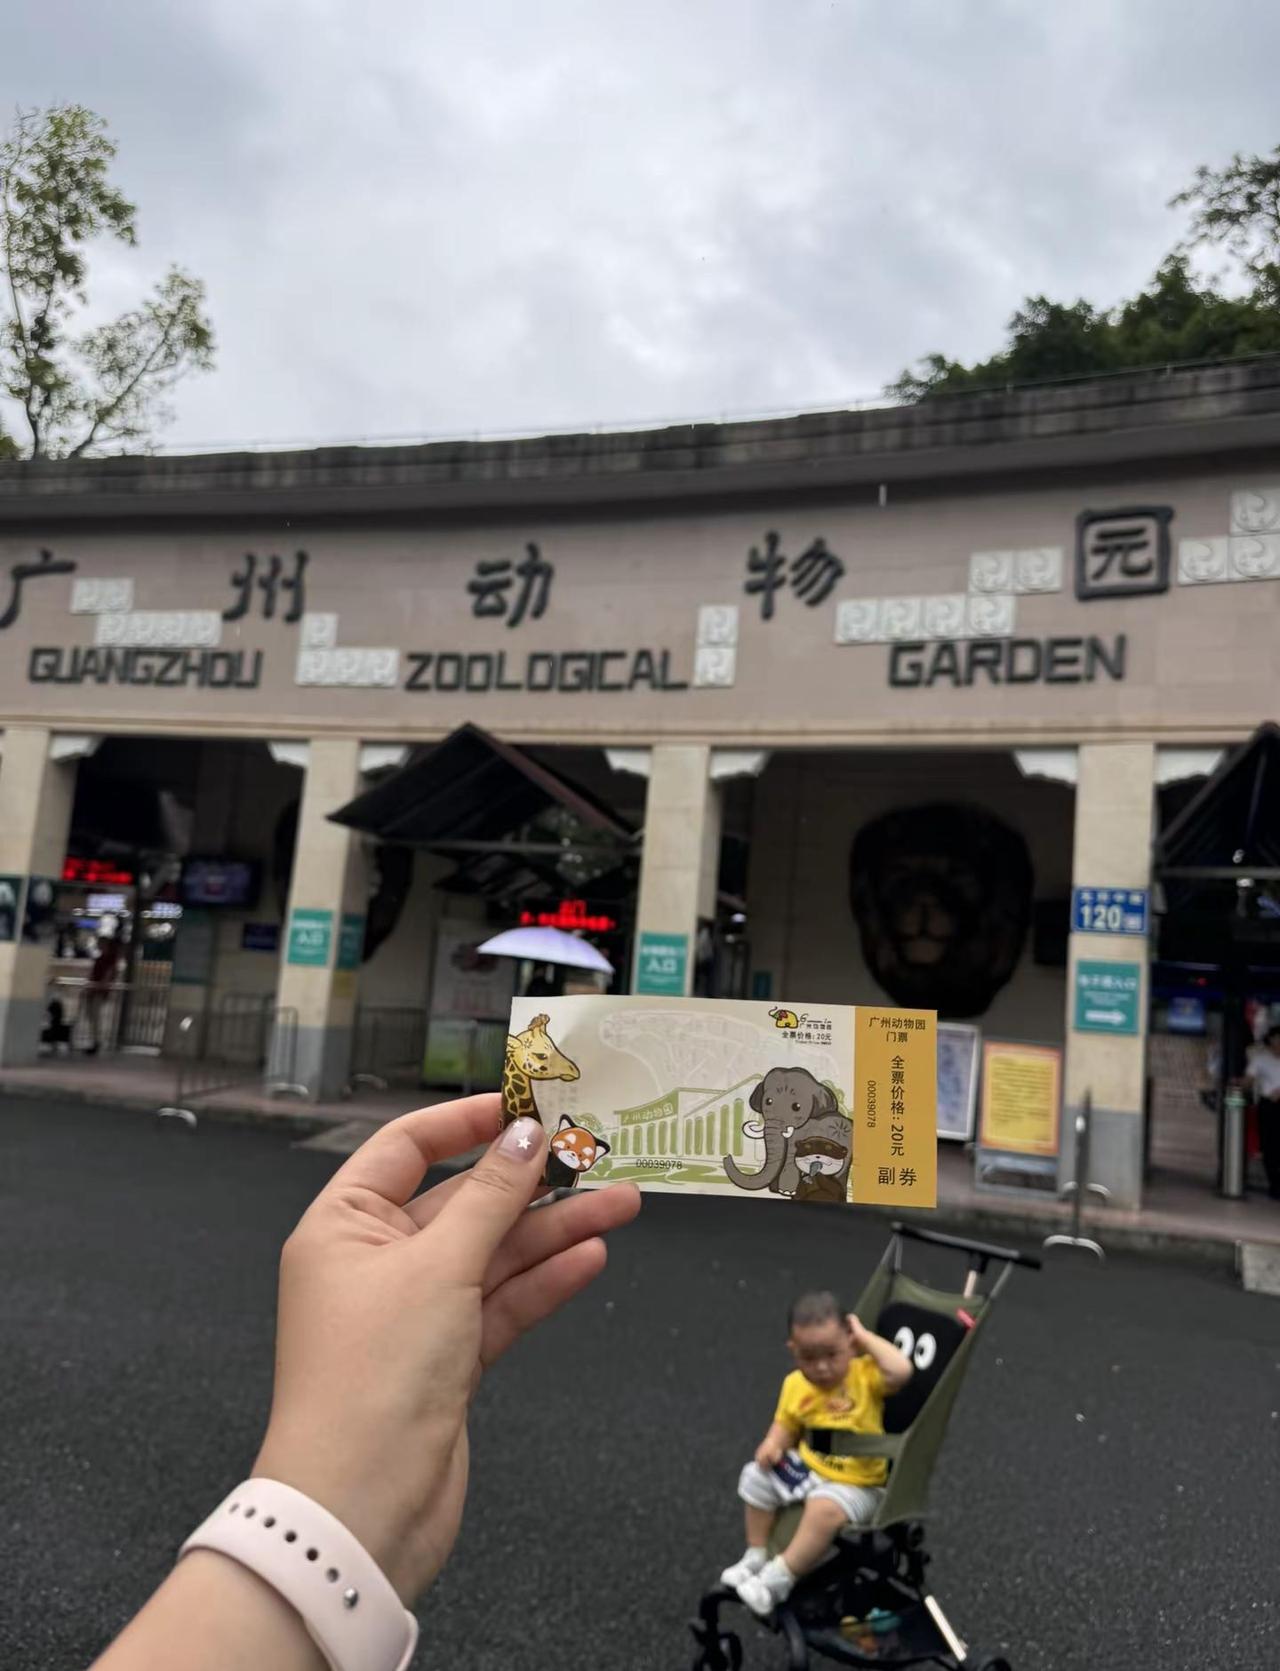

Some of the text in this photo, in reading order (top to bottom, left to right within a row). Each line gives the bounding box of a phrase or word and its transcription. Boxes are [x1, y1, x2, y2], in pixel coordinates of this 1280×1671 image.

[28, 634, 1127, 693] GUANGZHOU ZOOLOGICAL GARDEN
[869, 1016, 926, 1030] 广州动物园
[886, 1031, 908, 1042] 门票
[867, 1080, 877, 1128] 00039078
[635, 1158, 683, 1170] 00039078
[878, 1166, 917, 1186] 副券
